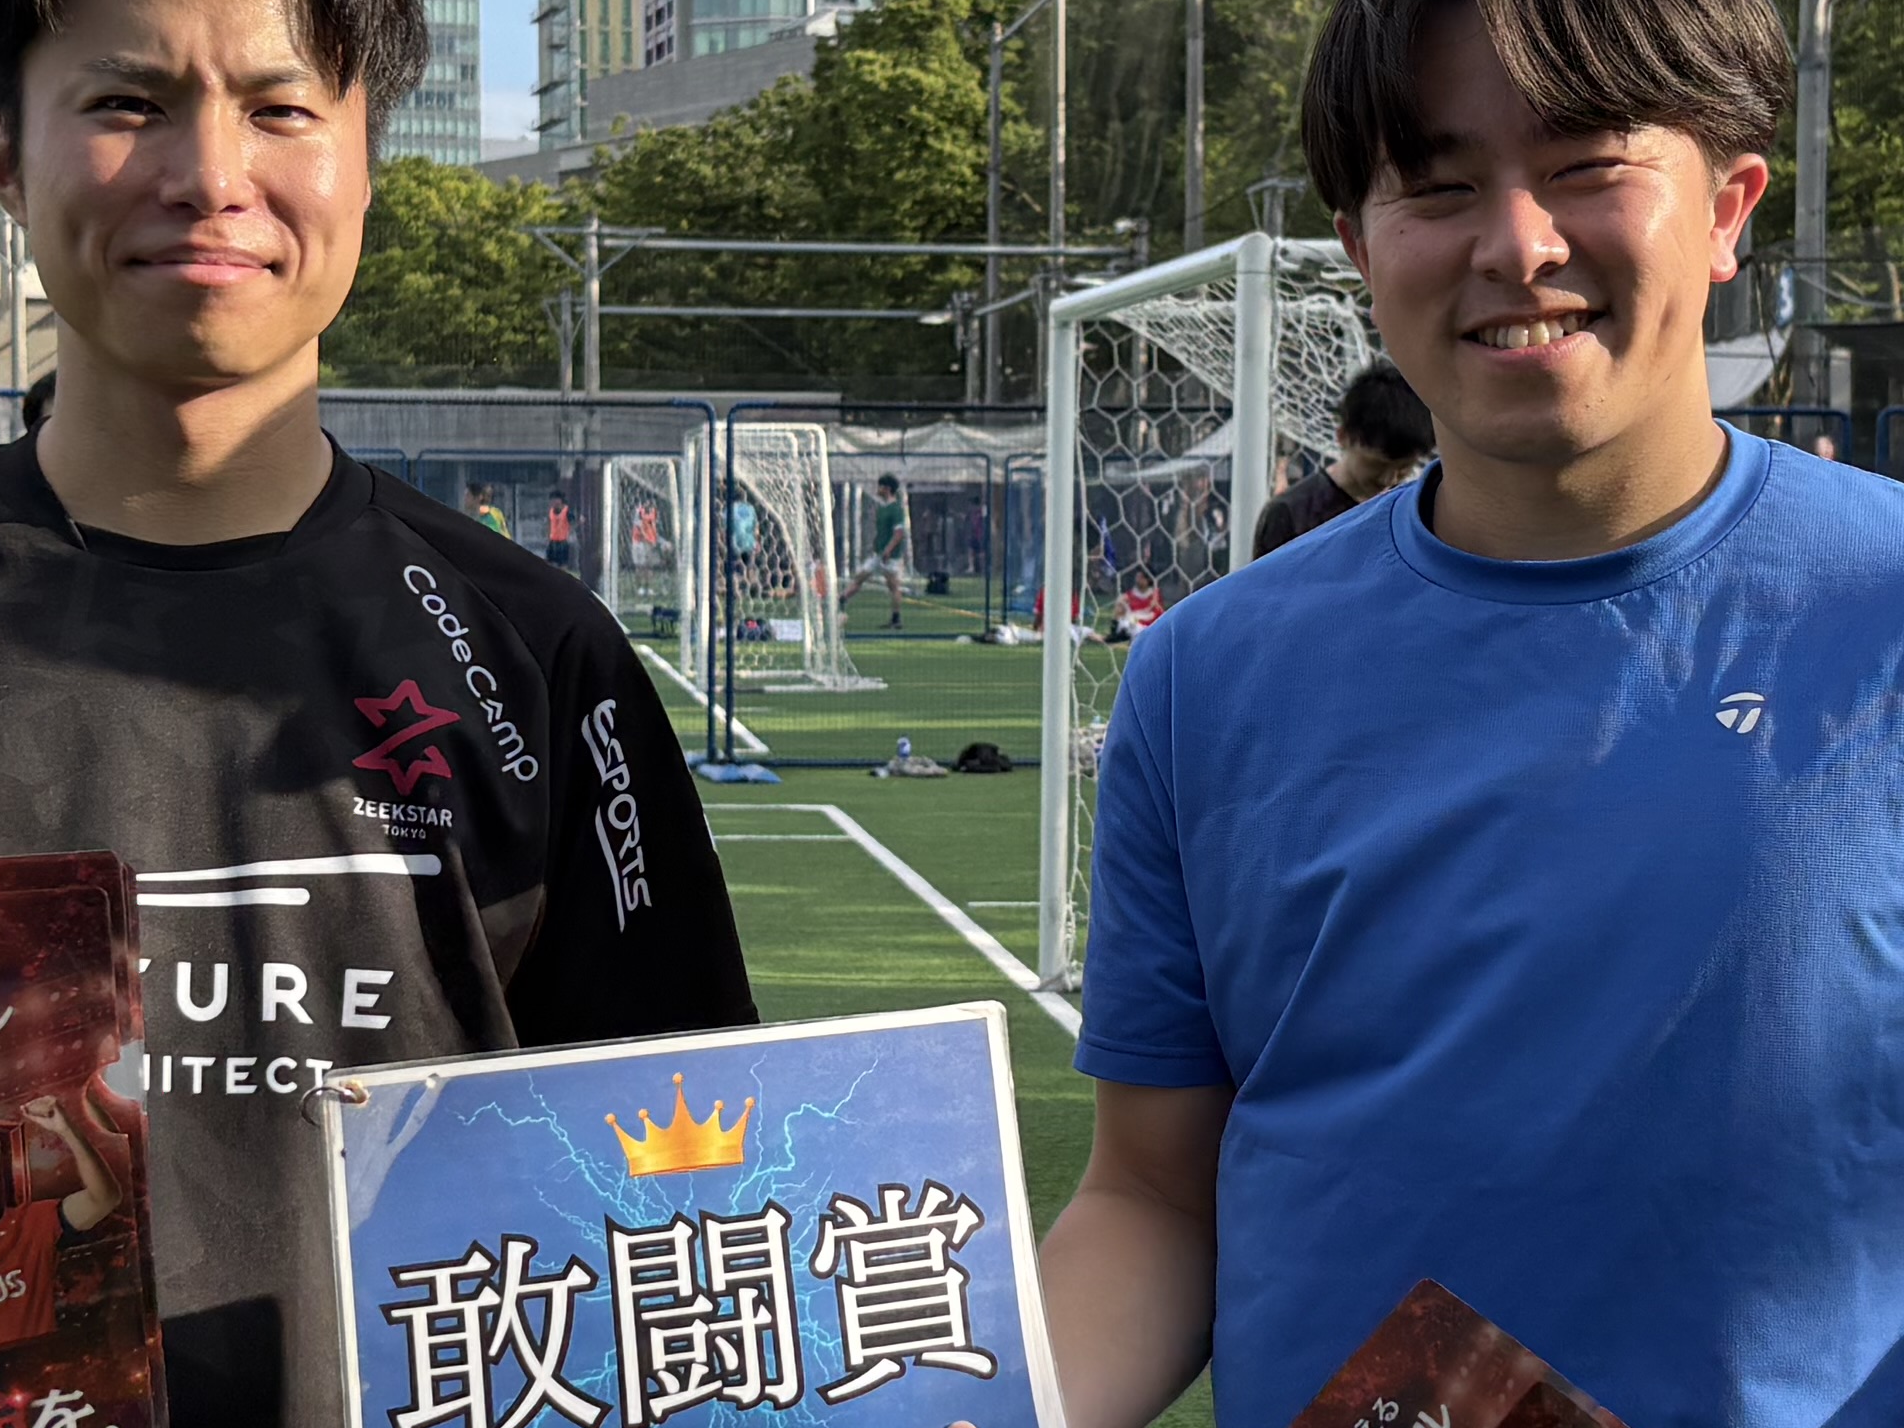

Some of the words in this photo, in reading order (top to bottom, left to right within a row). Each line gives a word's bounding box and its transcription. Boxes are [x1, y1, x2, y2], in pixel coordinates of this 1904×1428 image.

[353, 796, 453, 828] ZEEKSTAR
[381, 823, 427, 839] TOKYO
[139, 958, 395, 1030] URE
